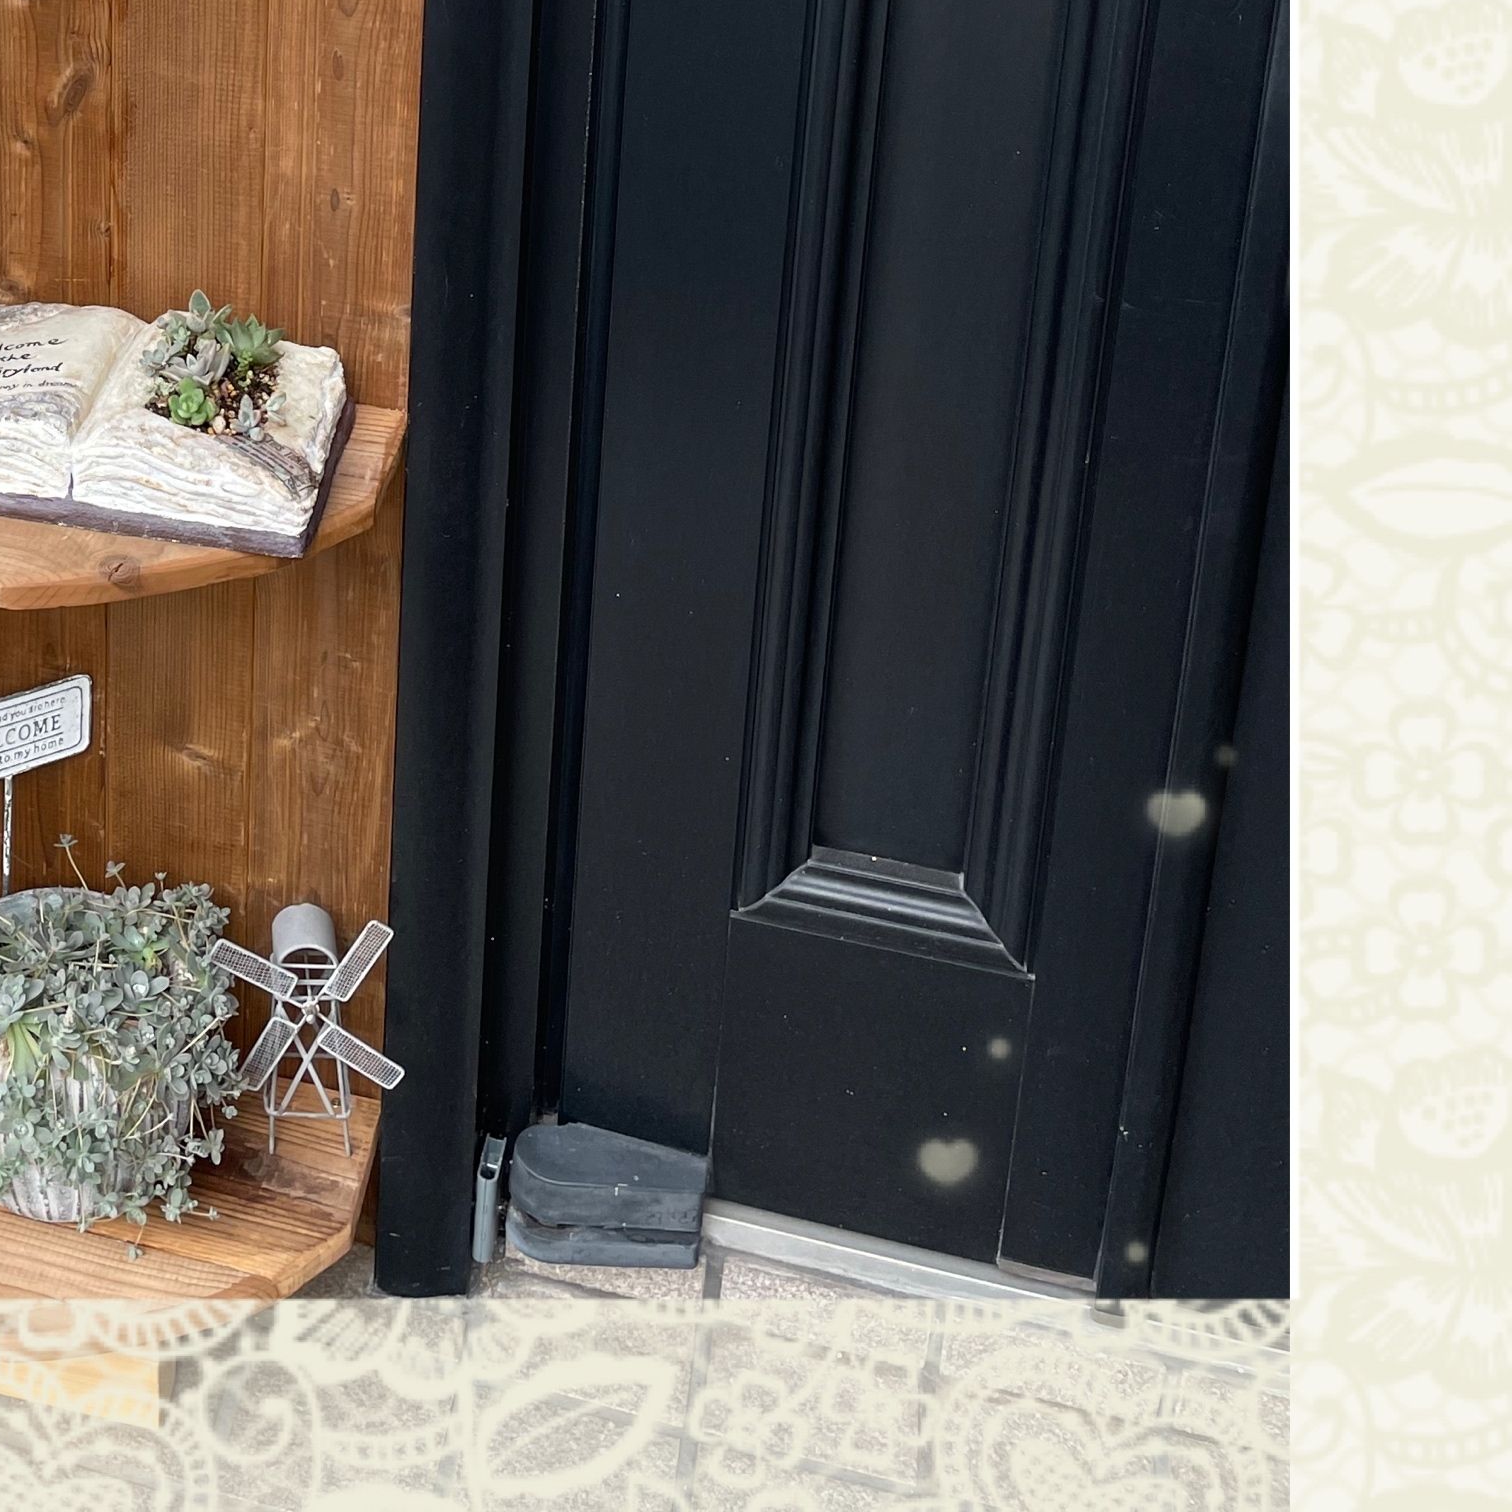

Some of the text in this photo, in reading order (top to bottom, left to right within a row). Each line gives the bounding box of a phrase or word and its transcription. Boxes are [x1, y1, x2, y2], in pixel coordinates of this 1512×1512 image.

[10, 709, 27, 721] you
[44, 696, 66, 709] here
[14, 747, 31, 761] my
[33, 737, 64, 753] home
